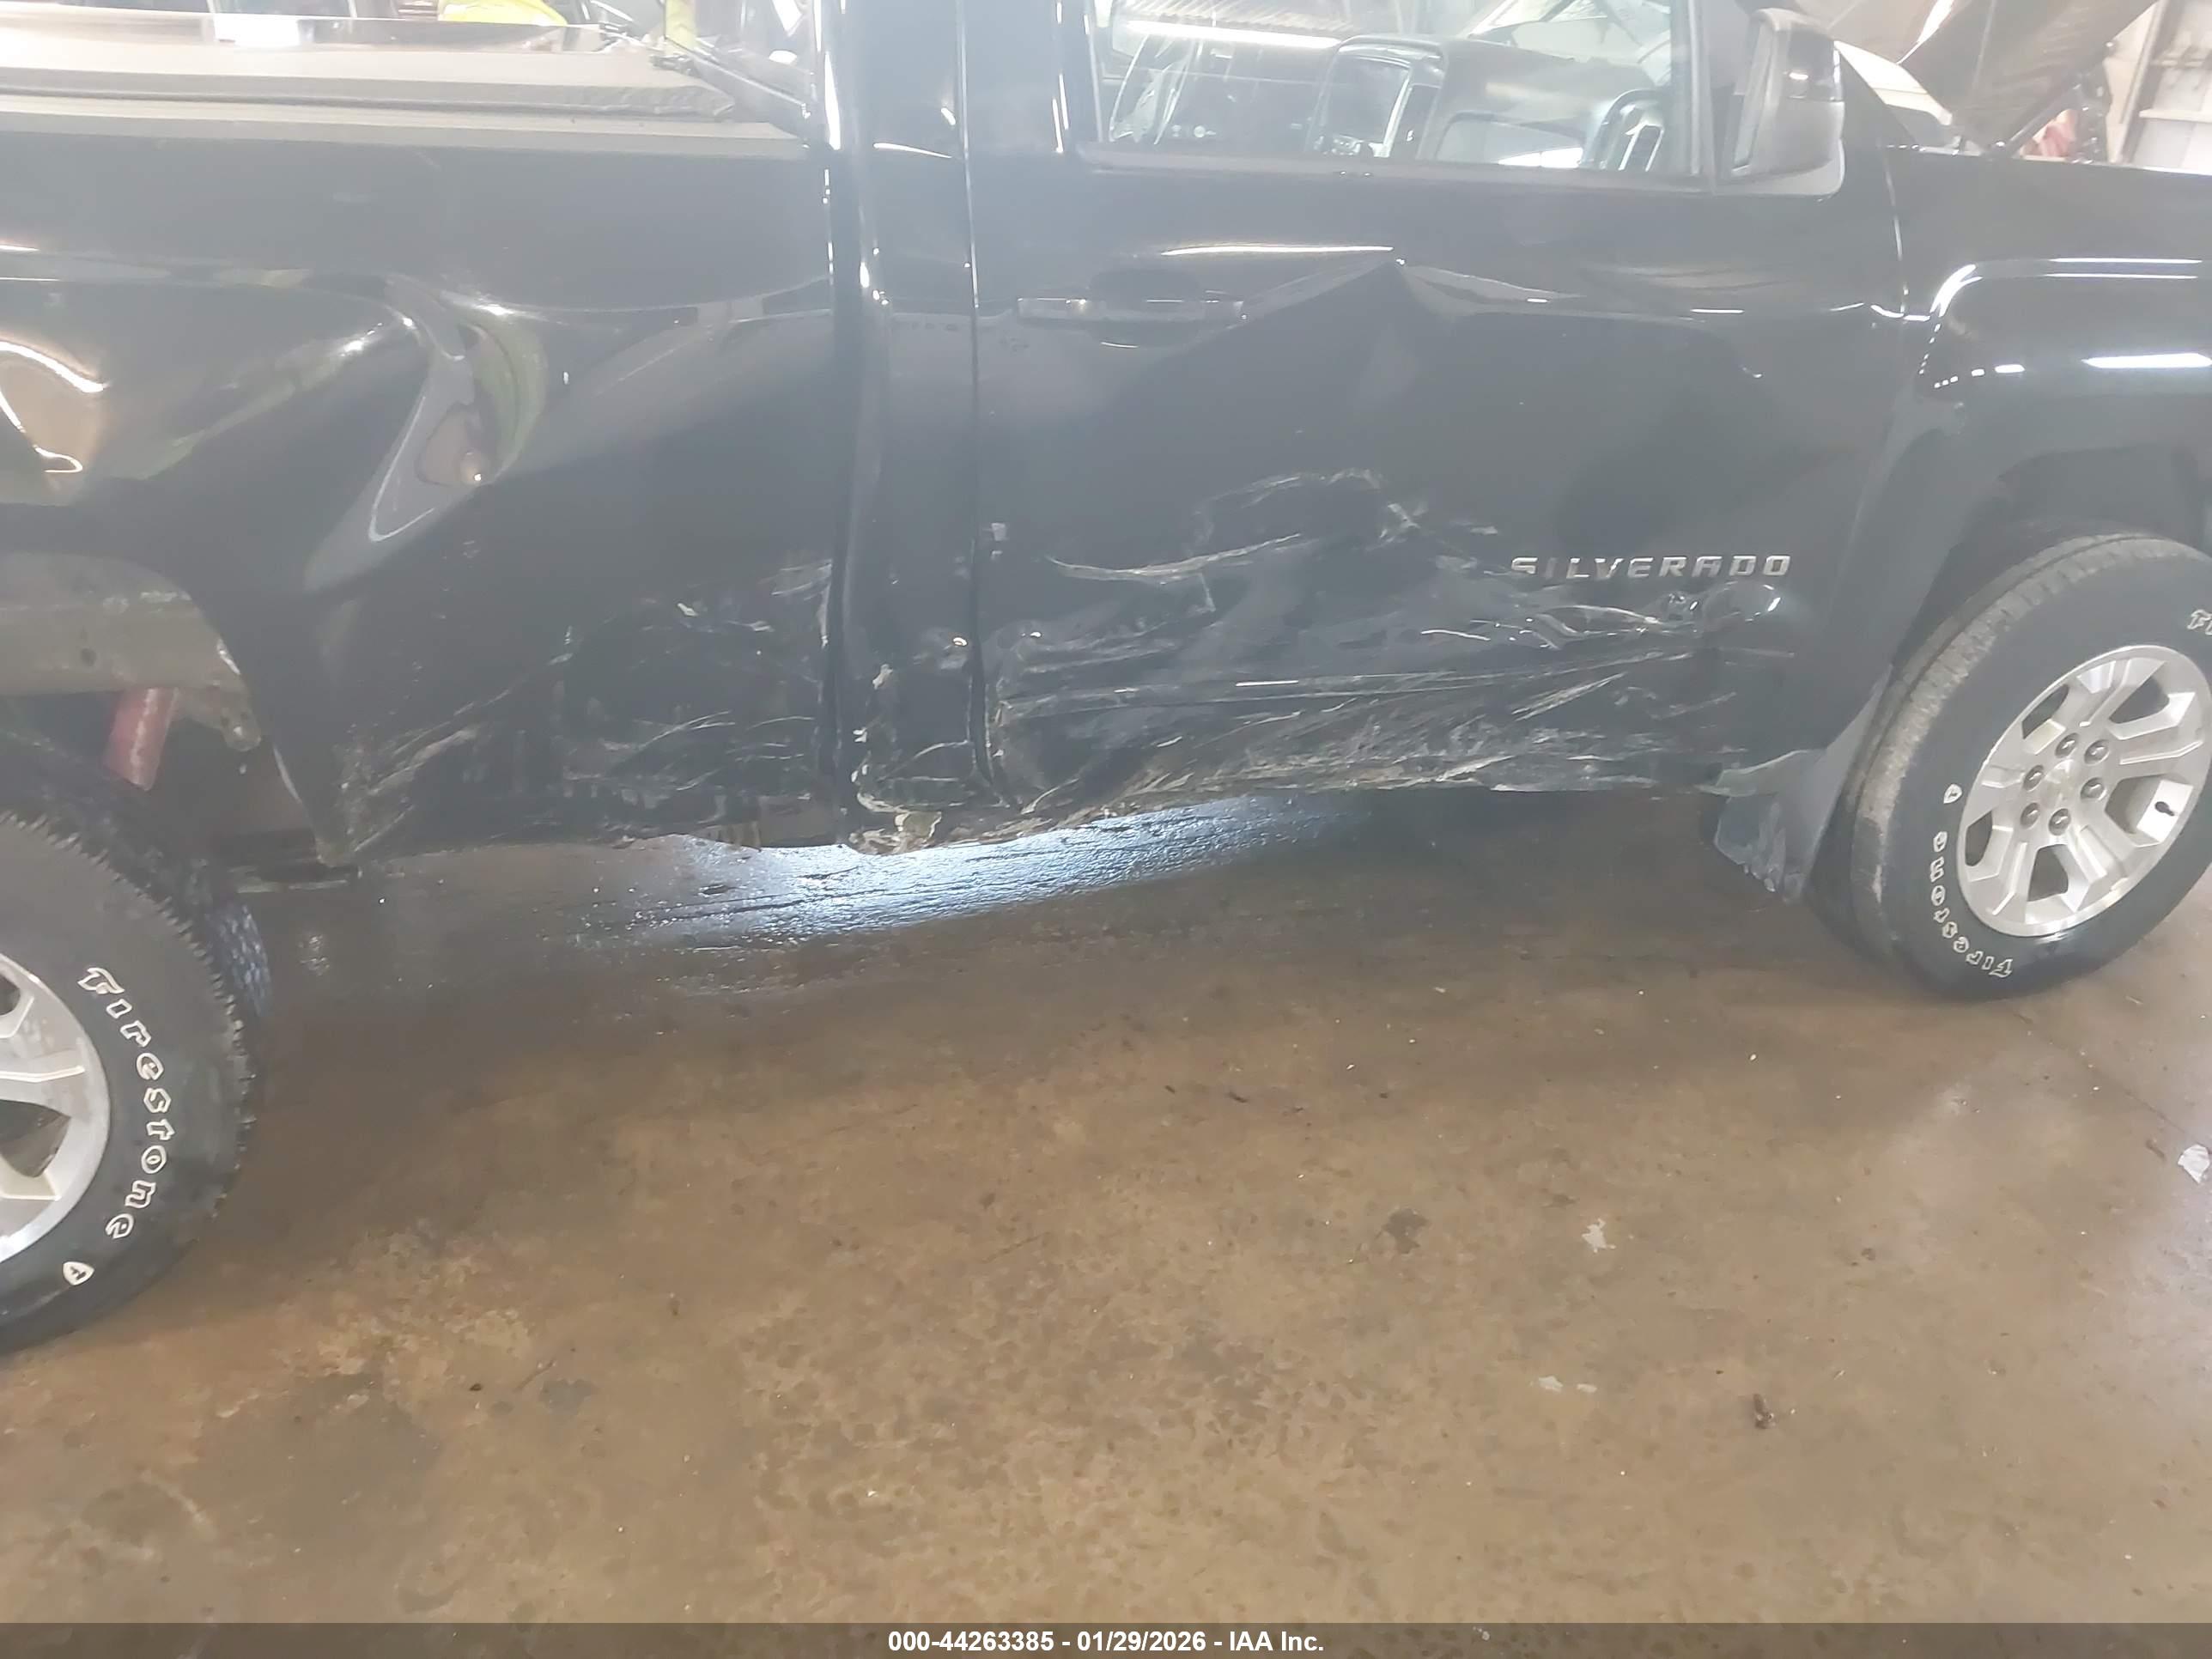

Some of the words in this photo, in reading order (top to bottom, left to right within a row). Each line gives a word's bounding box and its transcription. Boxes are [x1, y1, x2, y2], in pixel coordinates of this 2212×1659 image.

[1510, 556, 1791, 579] SILVERADO
[1929, 830, 2014, 978] Firestone
[77, 967, 174, 1239] Firestone
